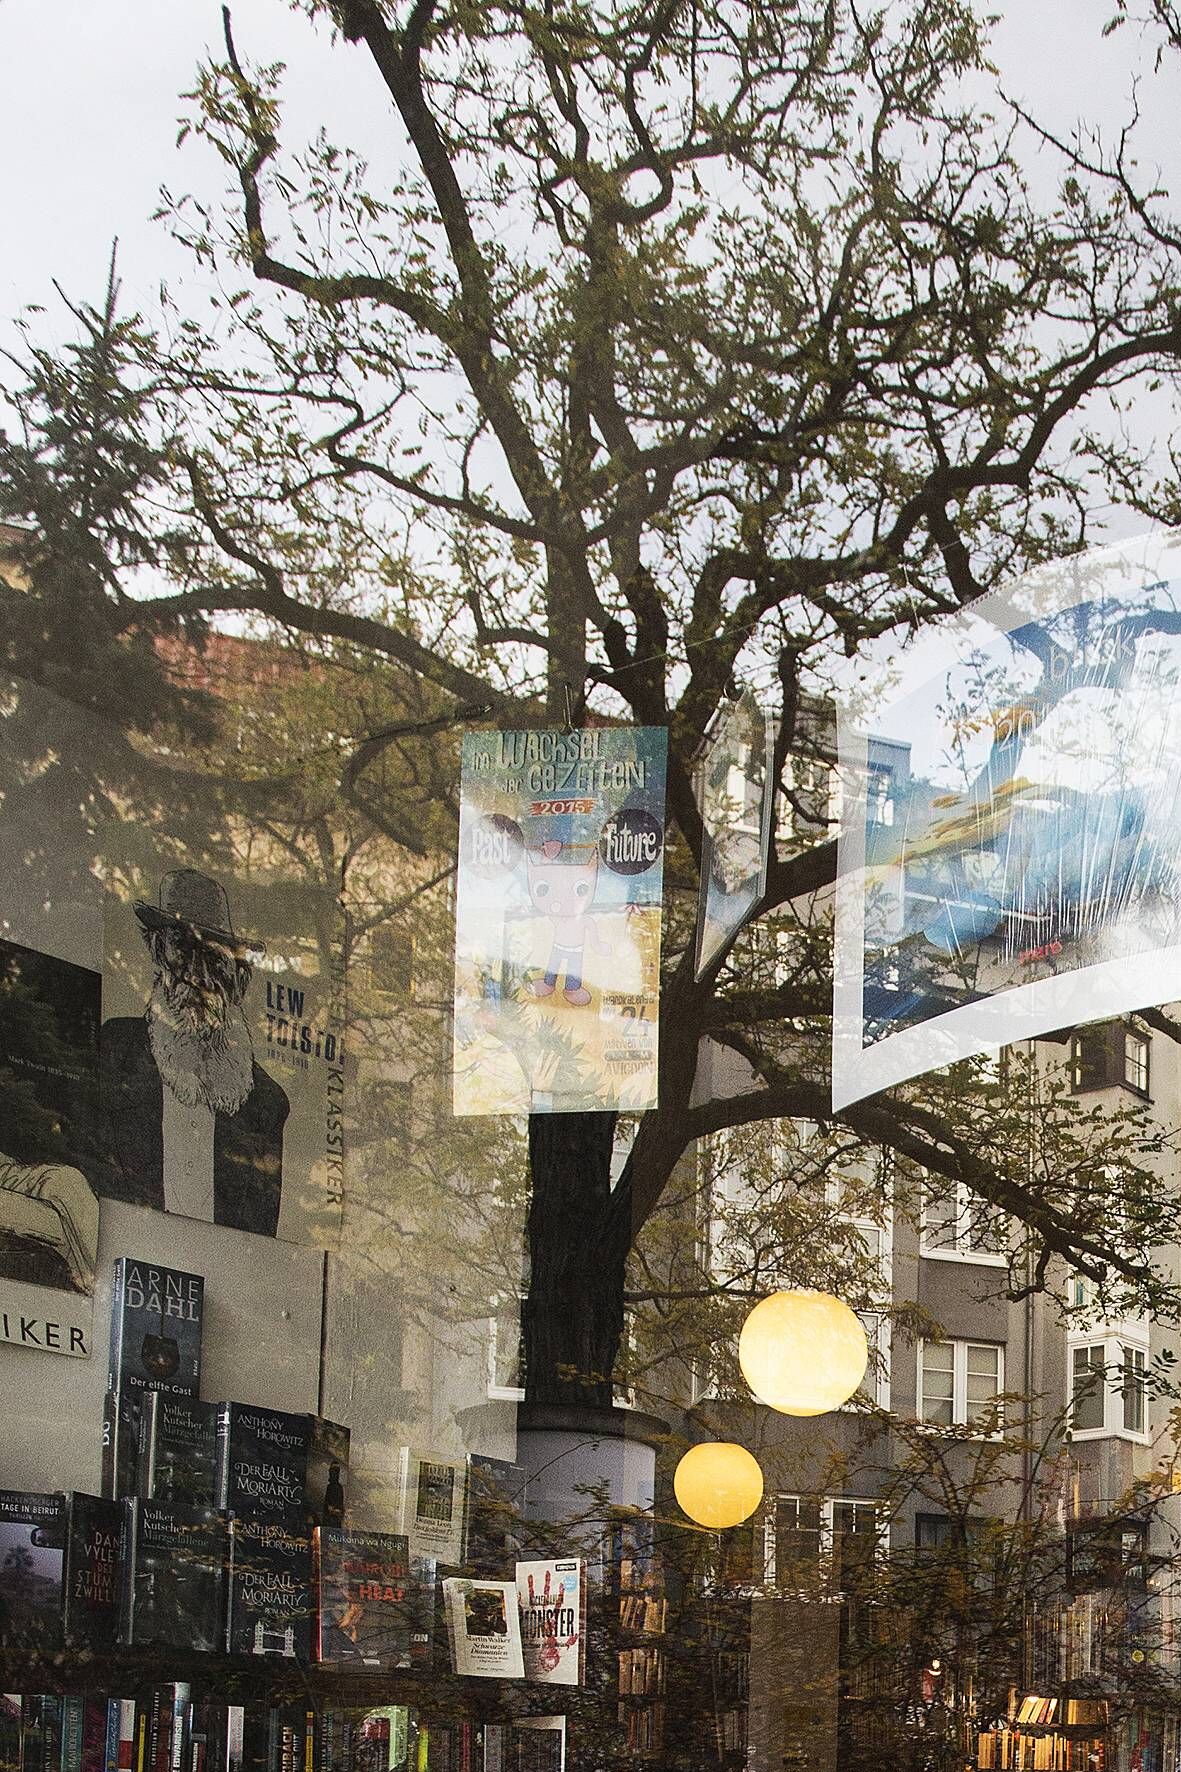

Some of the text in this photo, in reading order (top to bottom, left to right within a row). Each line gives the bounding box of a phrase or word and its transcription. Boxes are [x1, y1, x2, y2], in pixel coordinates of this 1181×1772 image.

[540, 801, 586, 814] 2015
[471, 827, 511, 866] Past
[605, 821, 657, 864] Future
[267, 980, 304, 1017] LEW
[327, 1067, 343, 1205] KLASSIKER
[127, 1266, 201, 1302] ARNE
[126, 1286, 200, 1322] DAHL
[130, 1376, 192, 1396] Der elfte Gast
[163, 1404, 192, 1418] Volker
[162, 1415, 203, 1430] Kutscher
[237, 1414, 284, 1430] ANTHONY
[257, 1428, 304, 1449] HOROWITZ
[237, 1477, 303, 1503] MORIARTY
[1, 1503, 19, 1513] TAGE
[32, 1506, 59, 1515] BEIRUT
[143, 1508, 174, 1521] Volker
[143, 1519, 186, 1534] Kutscher
[241, 1524, 287, 1538] ANTHONY
[261, 1538, 308, 1556] HOROWITZ
[366, 1537, 378, 1546] wa
[242, 1588, 306, 1612] MORIARTY
[172, 1716, 183, 1768] EDWARDSON
